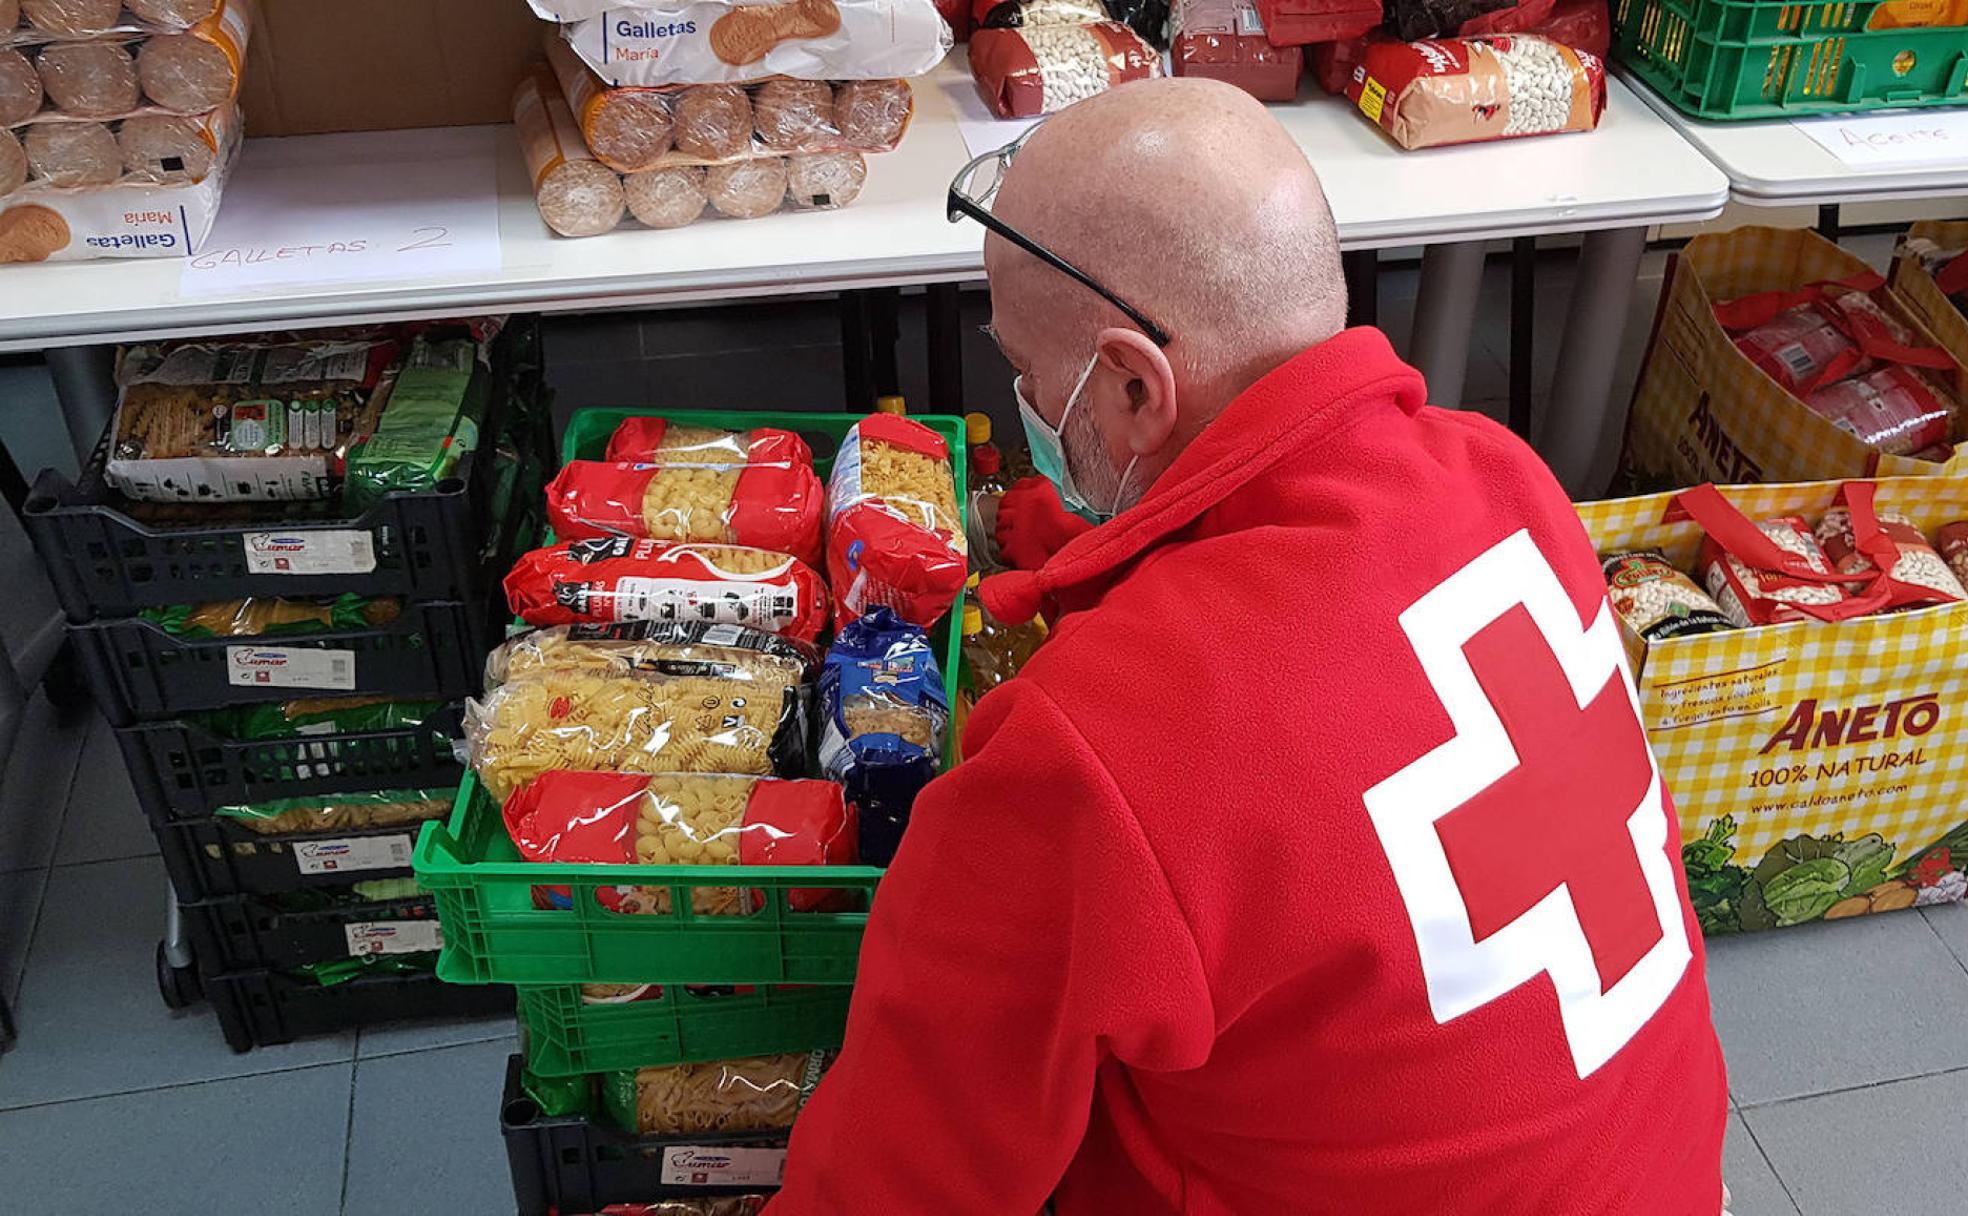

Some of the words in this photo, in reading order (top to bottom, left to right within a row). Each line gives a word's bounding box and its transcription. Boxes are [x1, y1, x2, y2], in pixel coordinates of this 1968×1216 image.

[616, 20, 697, 38] Galletas
[616, 47, 659, 61] María
[124, 211, 173, 226] María
[87, 233, 176, 249] Galletas
[191, 240, 366, 269] GALLETAS
[397, 226, 452, 252] 2
[1758, 693, 1940, 755] ANETO
[1749, 765, 1808, 788] 100%
[1816, 748, 1928, 780] NATURAL
[1752, 783, 1909, 814] www.caldoaneto.com
